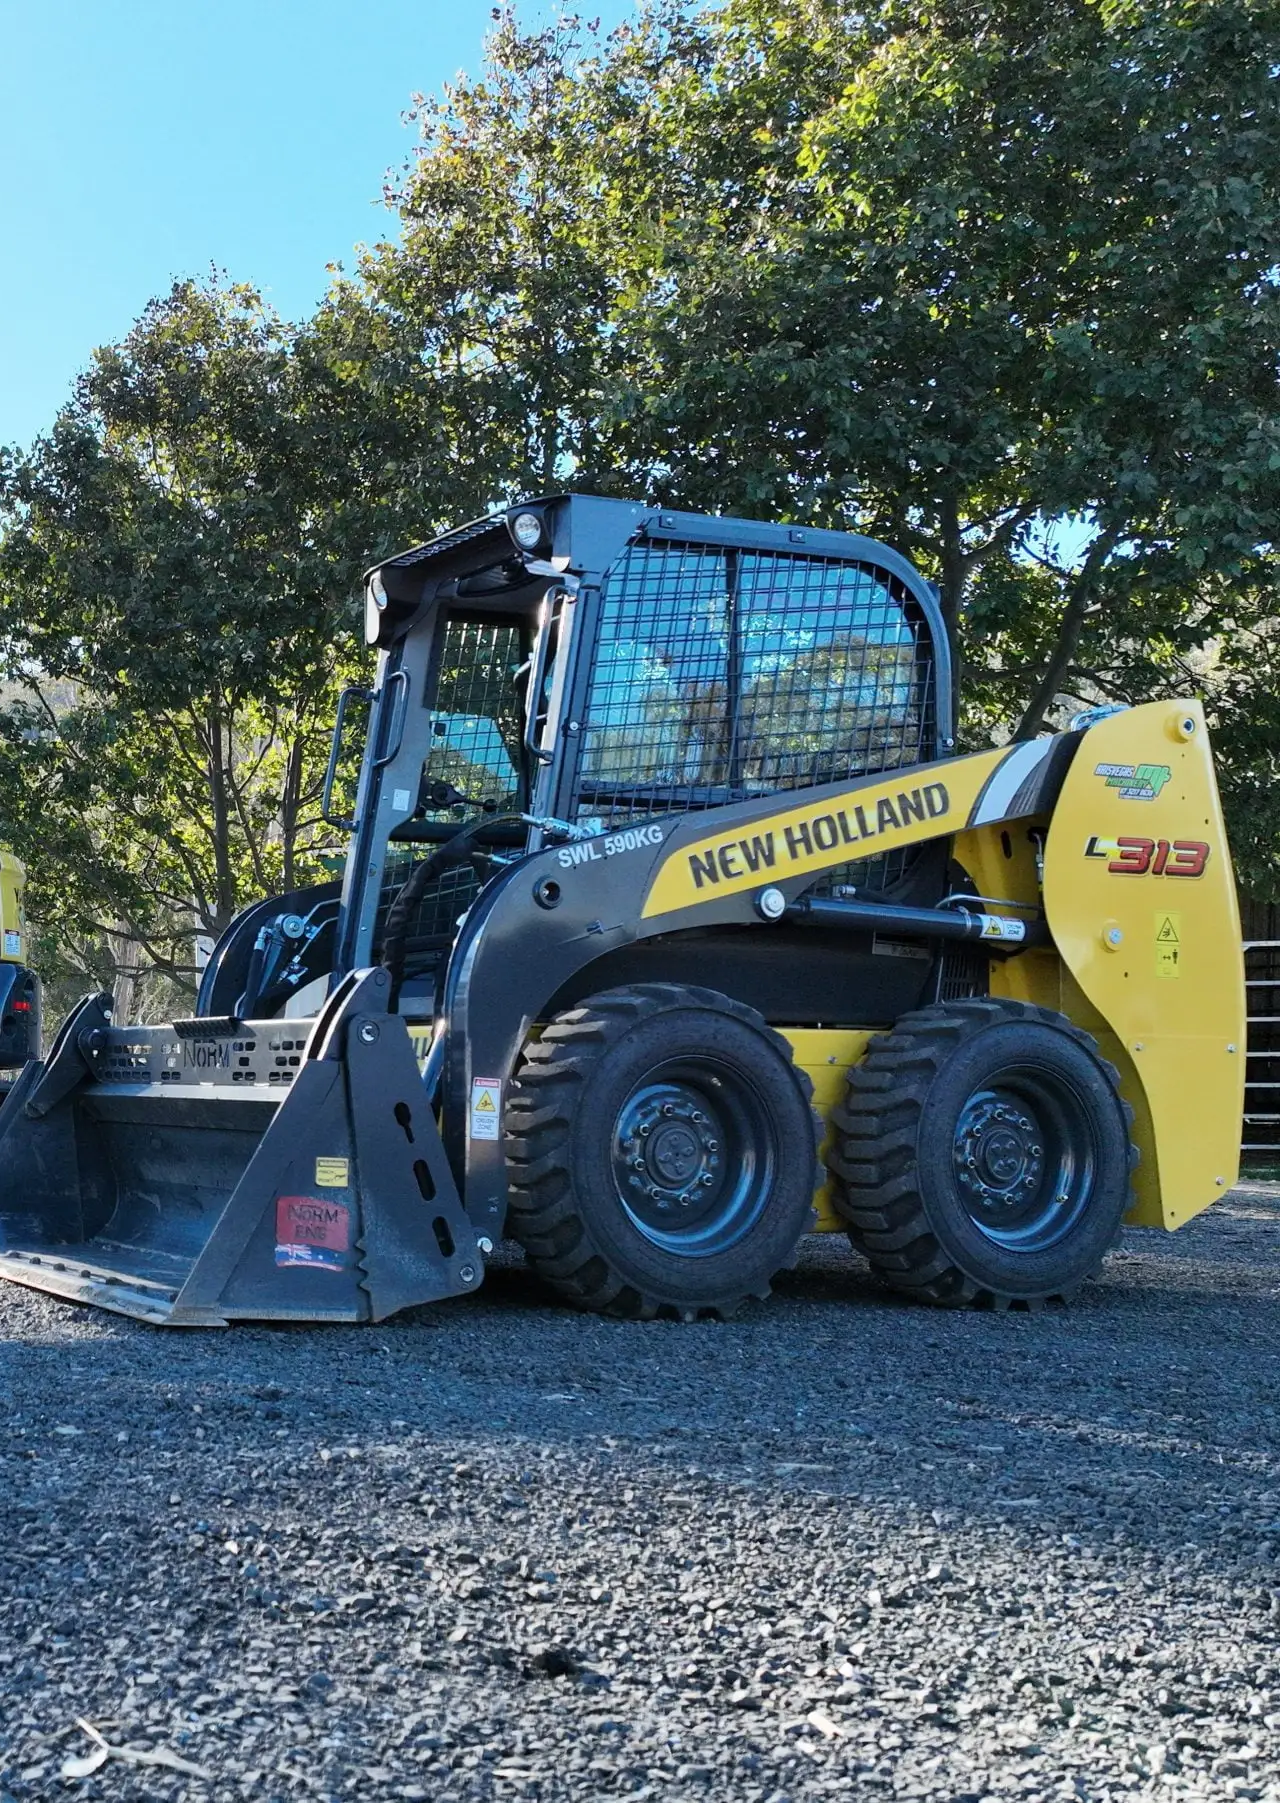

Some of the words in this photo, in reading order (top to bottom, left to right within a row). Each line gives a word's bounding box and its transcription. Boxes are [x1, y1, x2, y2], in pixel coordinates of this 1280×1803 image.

[558, 842, 602, 868] SWL
[604, 825, 663, 856] 590KG
[688, 831, 776, 888] NEW
[783, 782, 950, 860] HOLLAND
[183, 1040, 230, 1068] NORM
[287, 1203, 339, 1224] NORM
[295, 1224, 327, 1241] ENG
